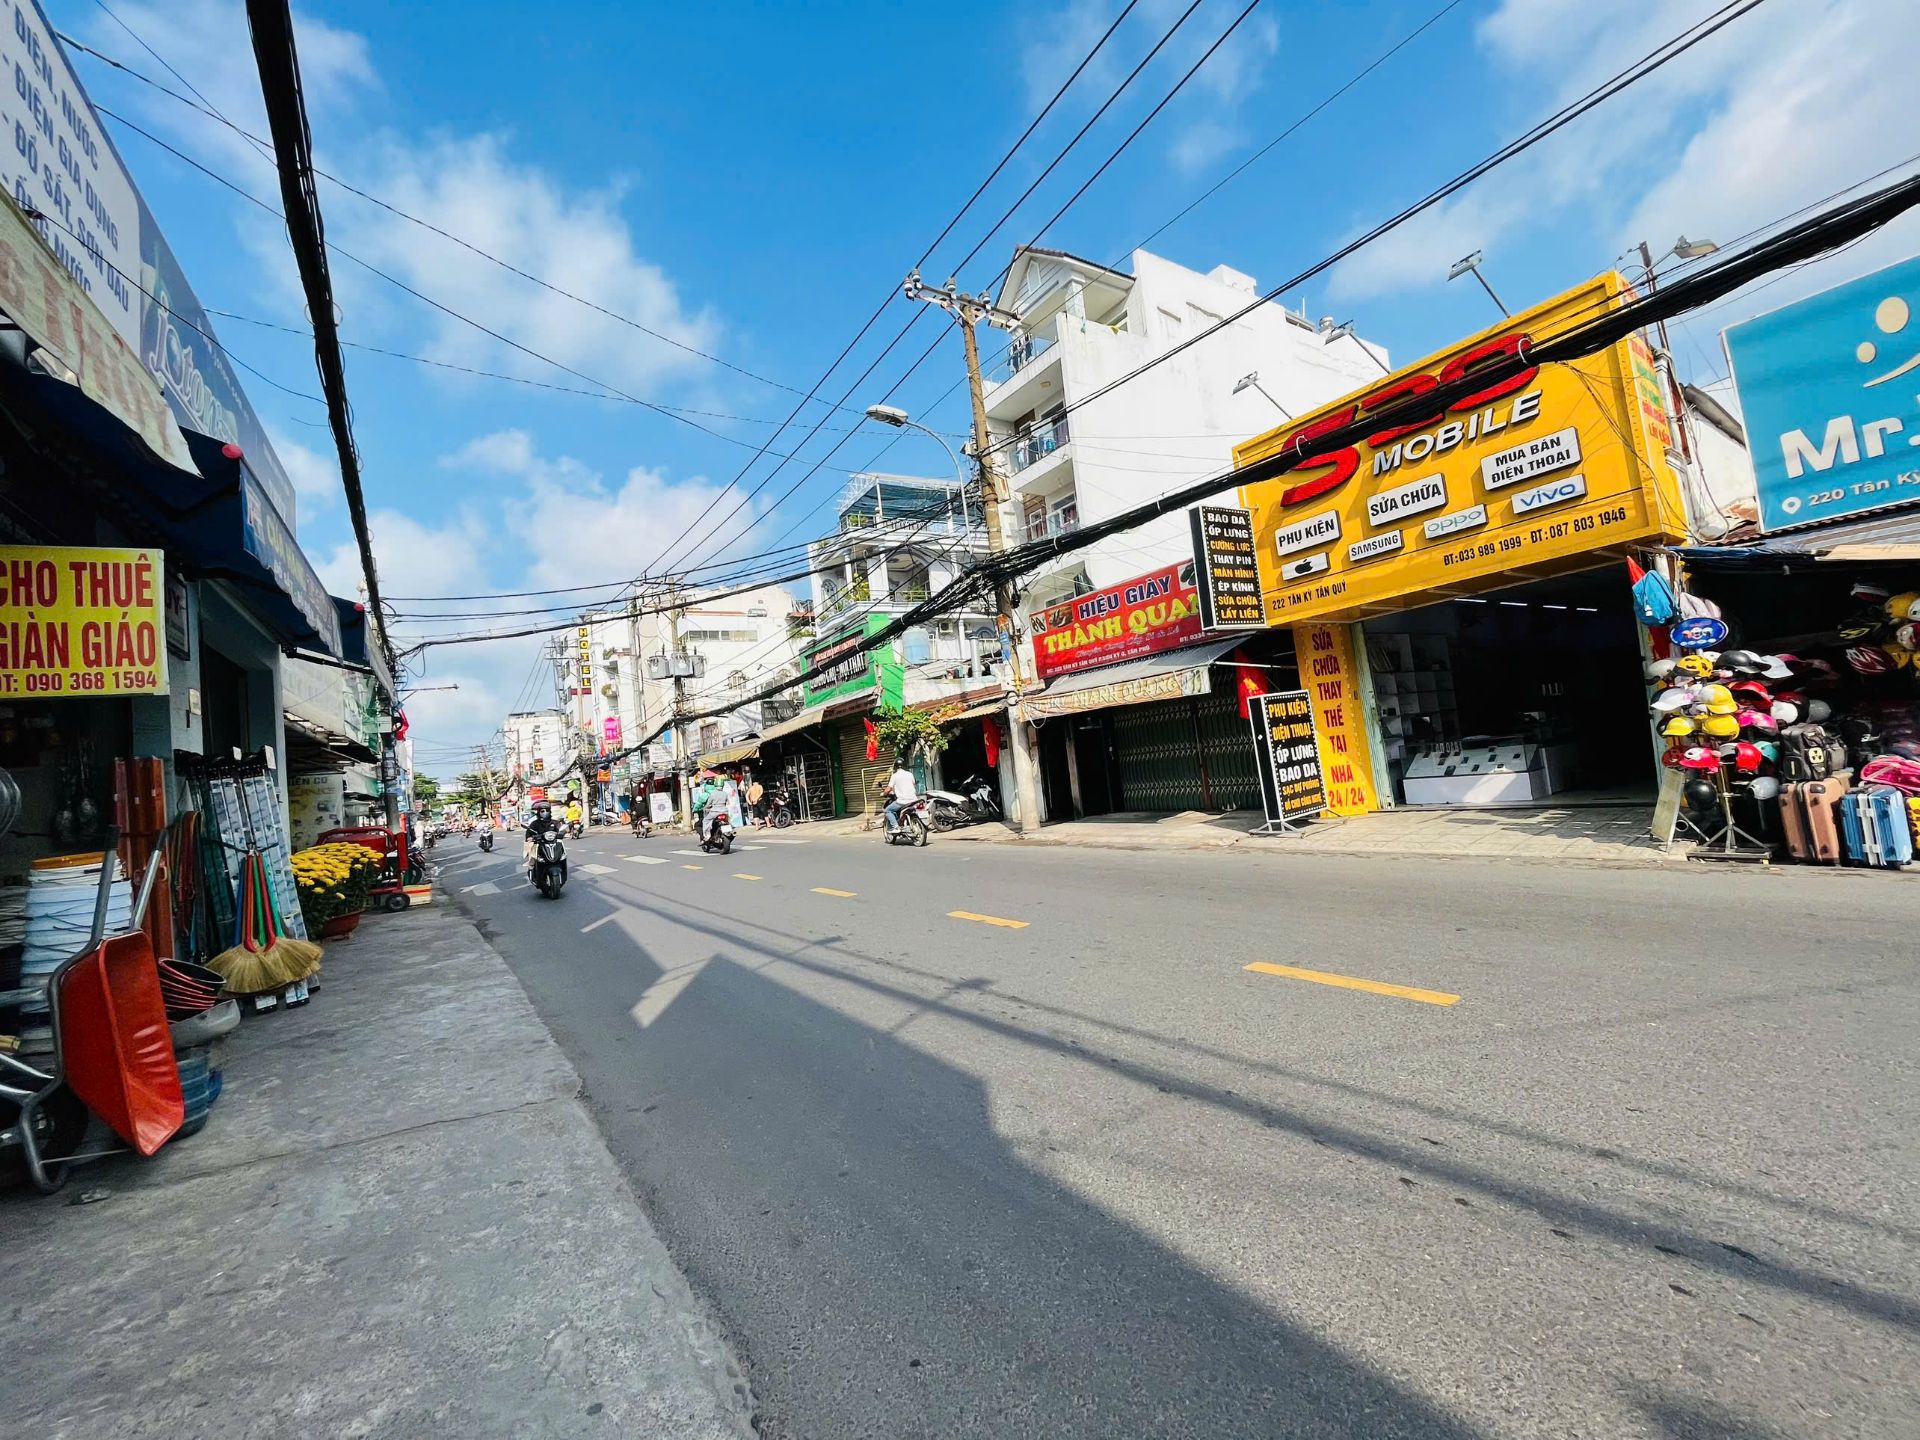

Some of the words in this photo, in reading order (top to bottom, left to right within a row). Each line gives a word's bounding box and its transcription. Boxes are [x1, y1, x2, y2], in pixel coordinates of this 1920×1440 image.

[62, 89, 98, 170] NƯỚC
[15, 60, 54, 147] ĐIỆN
[59, 135, 82, 194] GIA
[86, 178, 119, 252] DỤNG
[1373, 389, 1543, 476] MOBILE
[1495, 450, 1526, 467] MUA
[1531, 436, 1561, 456] BÁN
[1492, 466, 1524, 484] ĐIỆN
[1528, 449, 1570, 472] THOẠI
[1370, 496, 1399, 517] SỬA
[1401, 483, 1441, 507] CHỮA
[1520, 483, 1576, 507] vivo
[1808, 489, 1845, 506] 220
[1850, 479, 1890, 495] Tân
[1207, 513, 1229, 523] BAO
[1231, 515, 1246, 525] DA
[1208, 524, 1221, 536] ỐP
[1223, 528, 1249, 538] LƯNG
[1278, 530, 1302, 547] PHỤ
[1305, 518, 1335, 542] KIỆN
[1477, 542, 1496, 557] 989
[1499, 536, 1522, 552] 1999
[1574, 515, 1594, 532] 803
[1598, 507, 1626, 526] 1946
[1351, 534, 1399, 557] SAMSUNG
[1213, 554, 1234, 565] THAY
[1236, 556, 1251, 565] PIN
[69, 553, 153, 608] THUÊ
[1232, 581, 1254, 592] KÍNH
[1078, 592, 1120, 620] HIỆU
[1124, 575, 1171, 605] GIÀY
[1218, 593, 1235, 605] SỬA
[1236, 594, 1258, 605] CHỮA
[1272, 598, 1286, 610] 222
[1315, 585, 1330, 599] TÂN
[82, 611, 156, 668] GIÁO
[1044, 614, 1123, 654] THÀNH
[1312, 627, 1334, 651] SỬA
[578, 627, 592, 687] HOTEL
[1312, 654, 1341, 677] CHỮA
[0, 673, 18, 692] T:
[25, 672, 62, 692] 090
[70, 671, 105, 690] 368
[112, 670, 157, 689] 1594
[1317, 680, 1342, 700] THAY
[1268, 702, 1287, 719] PHỤ
[1287, 698, 1308, 717] KIỆN
[1324, 703, 1344, 728] THẾ
[1276, 744, 1289, 763] ỐP
[1290, 743, 1315, 761] LƯNG
[1329, 735, 1347, 756] TẠI
[1279, 766, 1301, 783] BAO
[1302, 762, 1317, 777] DA
